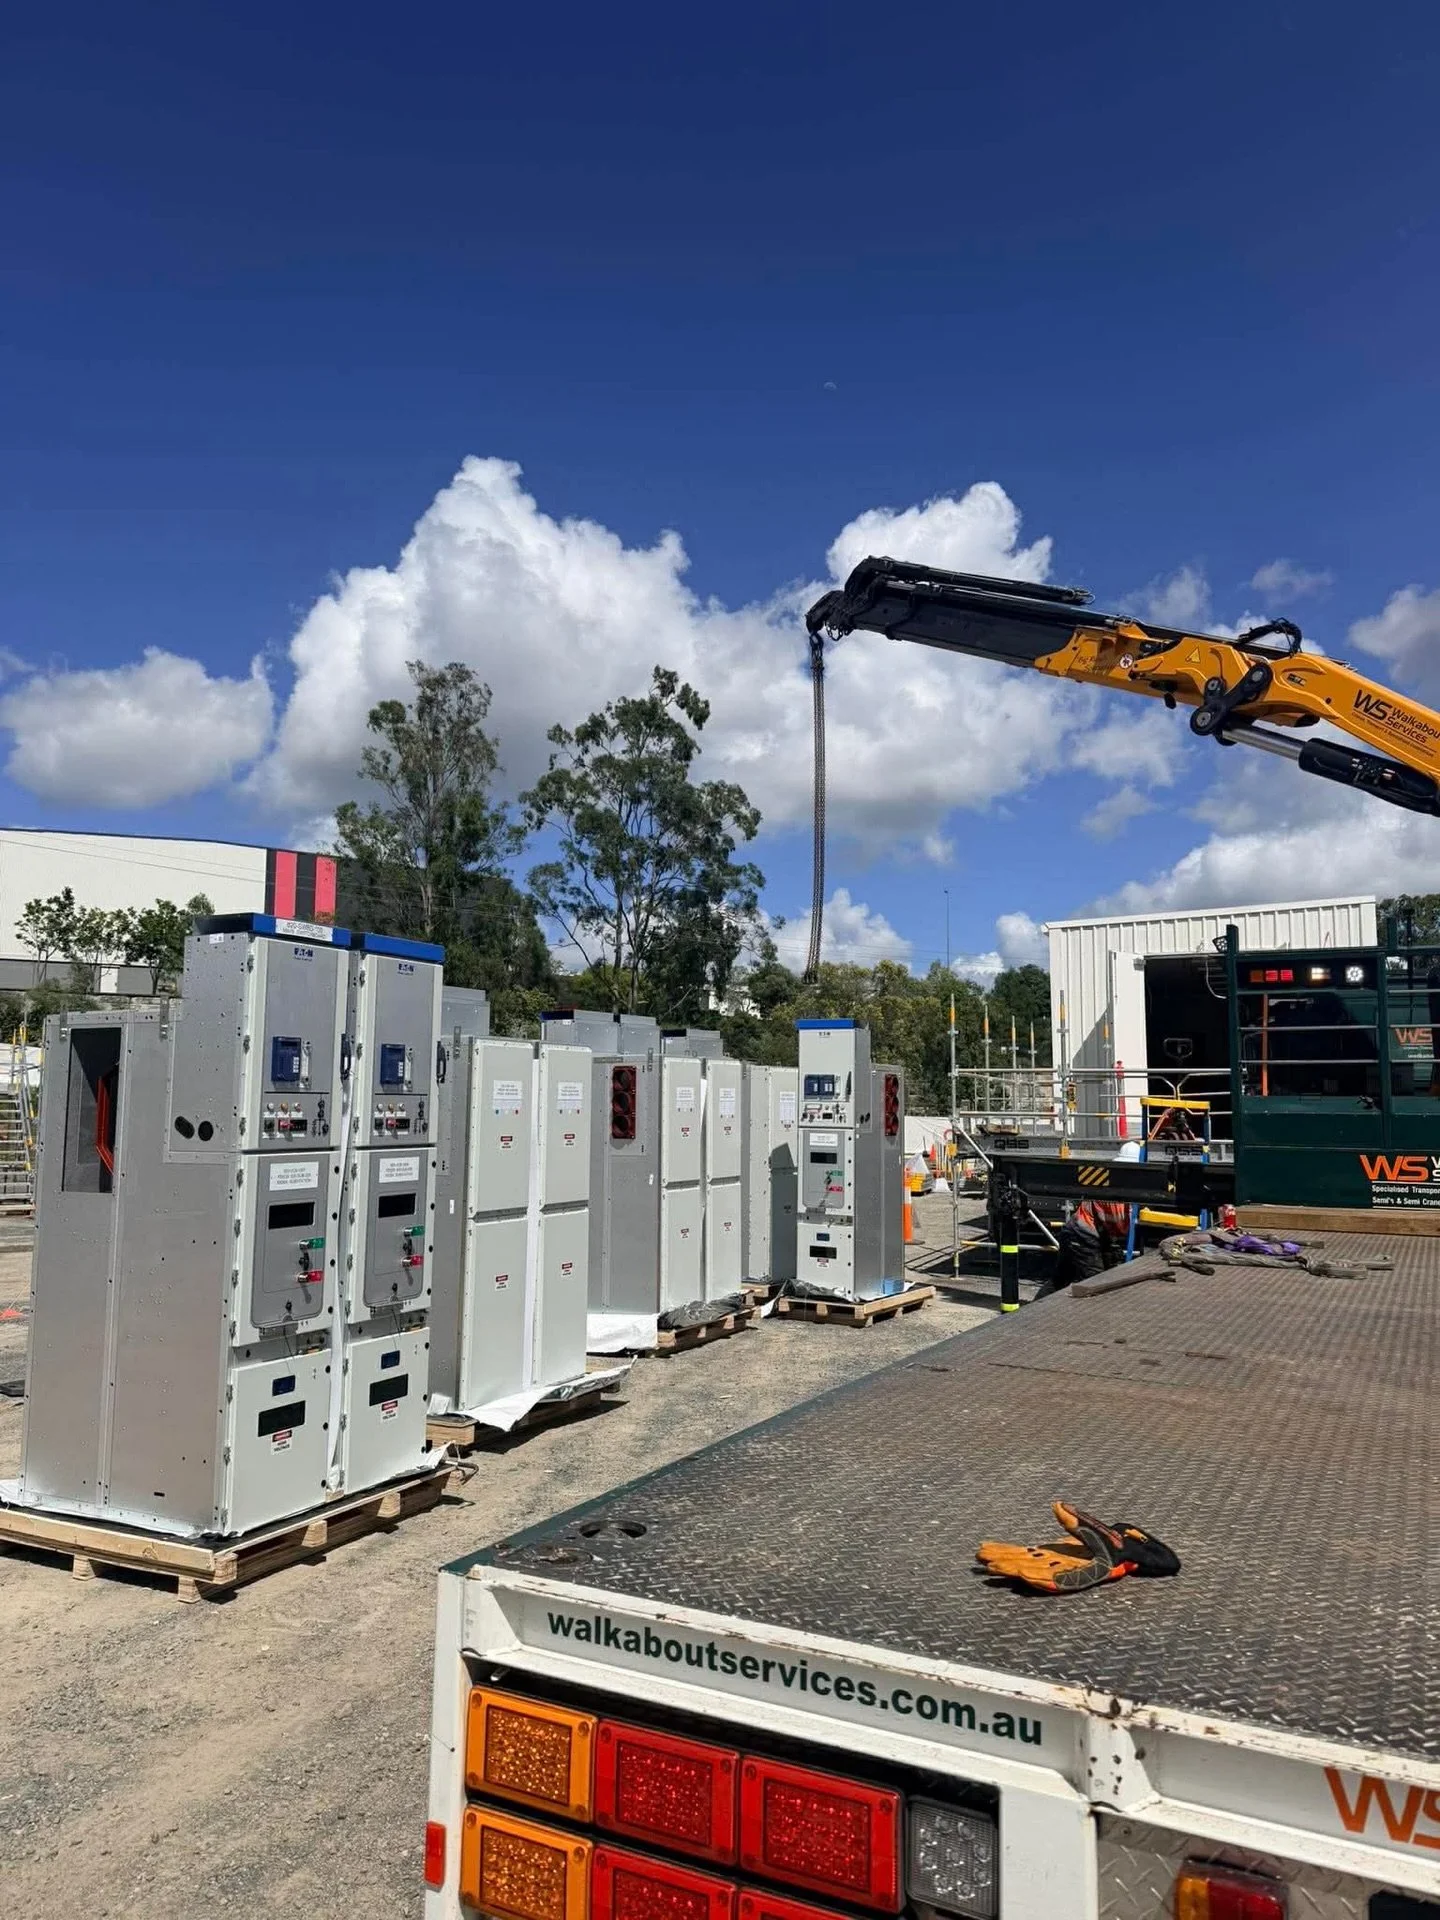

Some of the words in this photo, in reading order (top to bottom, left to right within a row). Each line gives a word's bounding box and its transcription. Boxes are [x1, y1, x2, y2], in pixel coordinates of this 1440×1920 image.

[1354, 689, 1393, 721] WS
[1385, 716, 1428, 744] Services
[1359, 1154, 1429, 1181] WS
[1372, 1184, 1409, 1193] Specialised
[1396, 1197, 1402, 1205] &
[1403, 1197, 1421, 1206] Semi
[547, 1611, 1043, 1745] walkaboutservices.com.au
[1323, 1764, 1440, 1850] W
